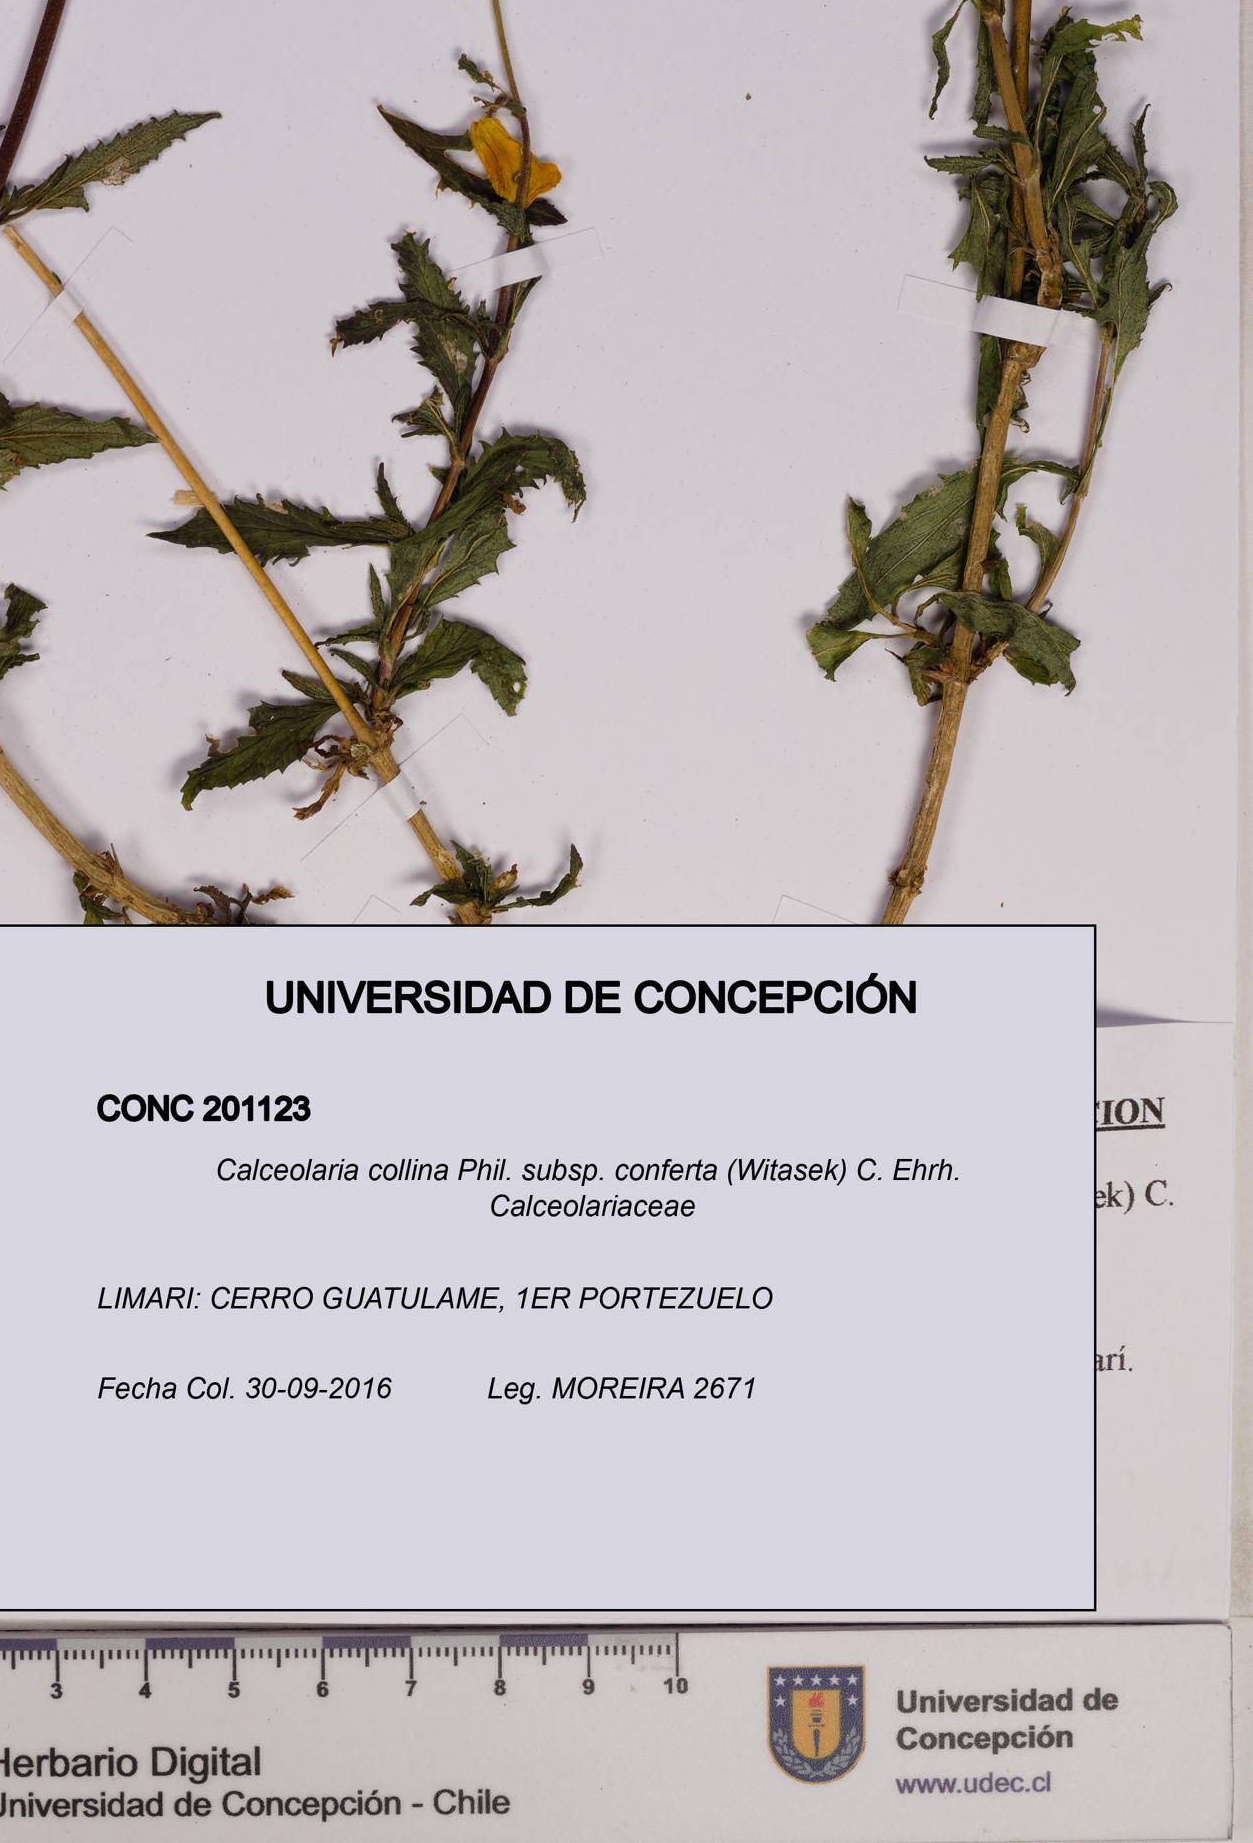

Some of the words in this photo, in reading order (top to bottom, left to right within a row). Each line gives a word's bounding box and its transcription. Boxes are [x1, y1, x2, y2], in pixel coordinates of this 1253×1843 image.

[1097, 1096, 1166, 1126] ION
[1144, 1179, 1174, 1207] C.
[50, 1683, 63, 1700] 3
[138, 1682, 152, 1699] 4
[227, 1682, 241, 1699] 5
[316, 1681, 329, 1698] 6
[405, 1680, 417, 1697] 7
[493, 1679, 507, 1696] 8
[582, 1679, 595, 1695] 9
[663, 1677, 688, 1694] 10
[897, 1687, 1073, 1714] Universidad
[1082, 1687, 1119, 1711] de
[895, 1723, 1074, 1755] Concepción
[151, 1745, 261, 1785] Digital
[895, 1771, 1051, 1795] www.udec.cl
[173, 1790, 212, 1818] de
[221, 1789, 402, 1823] Concepción
[433, 1788, 511, 1816] Chile
